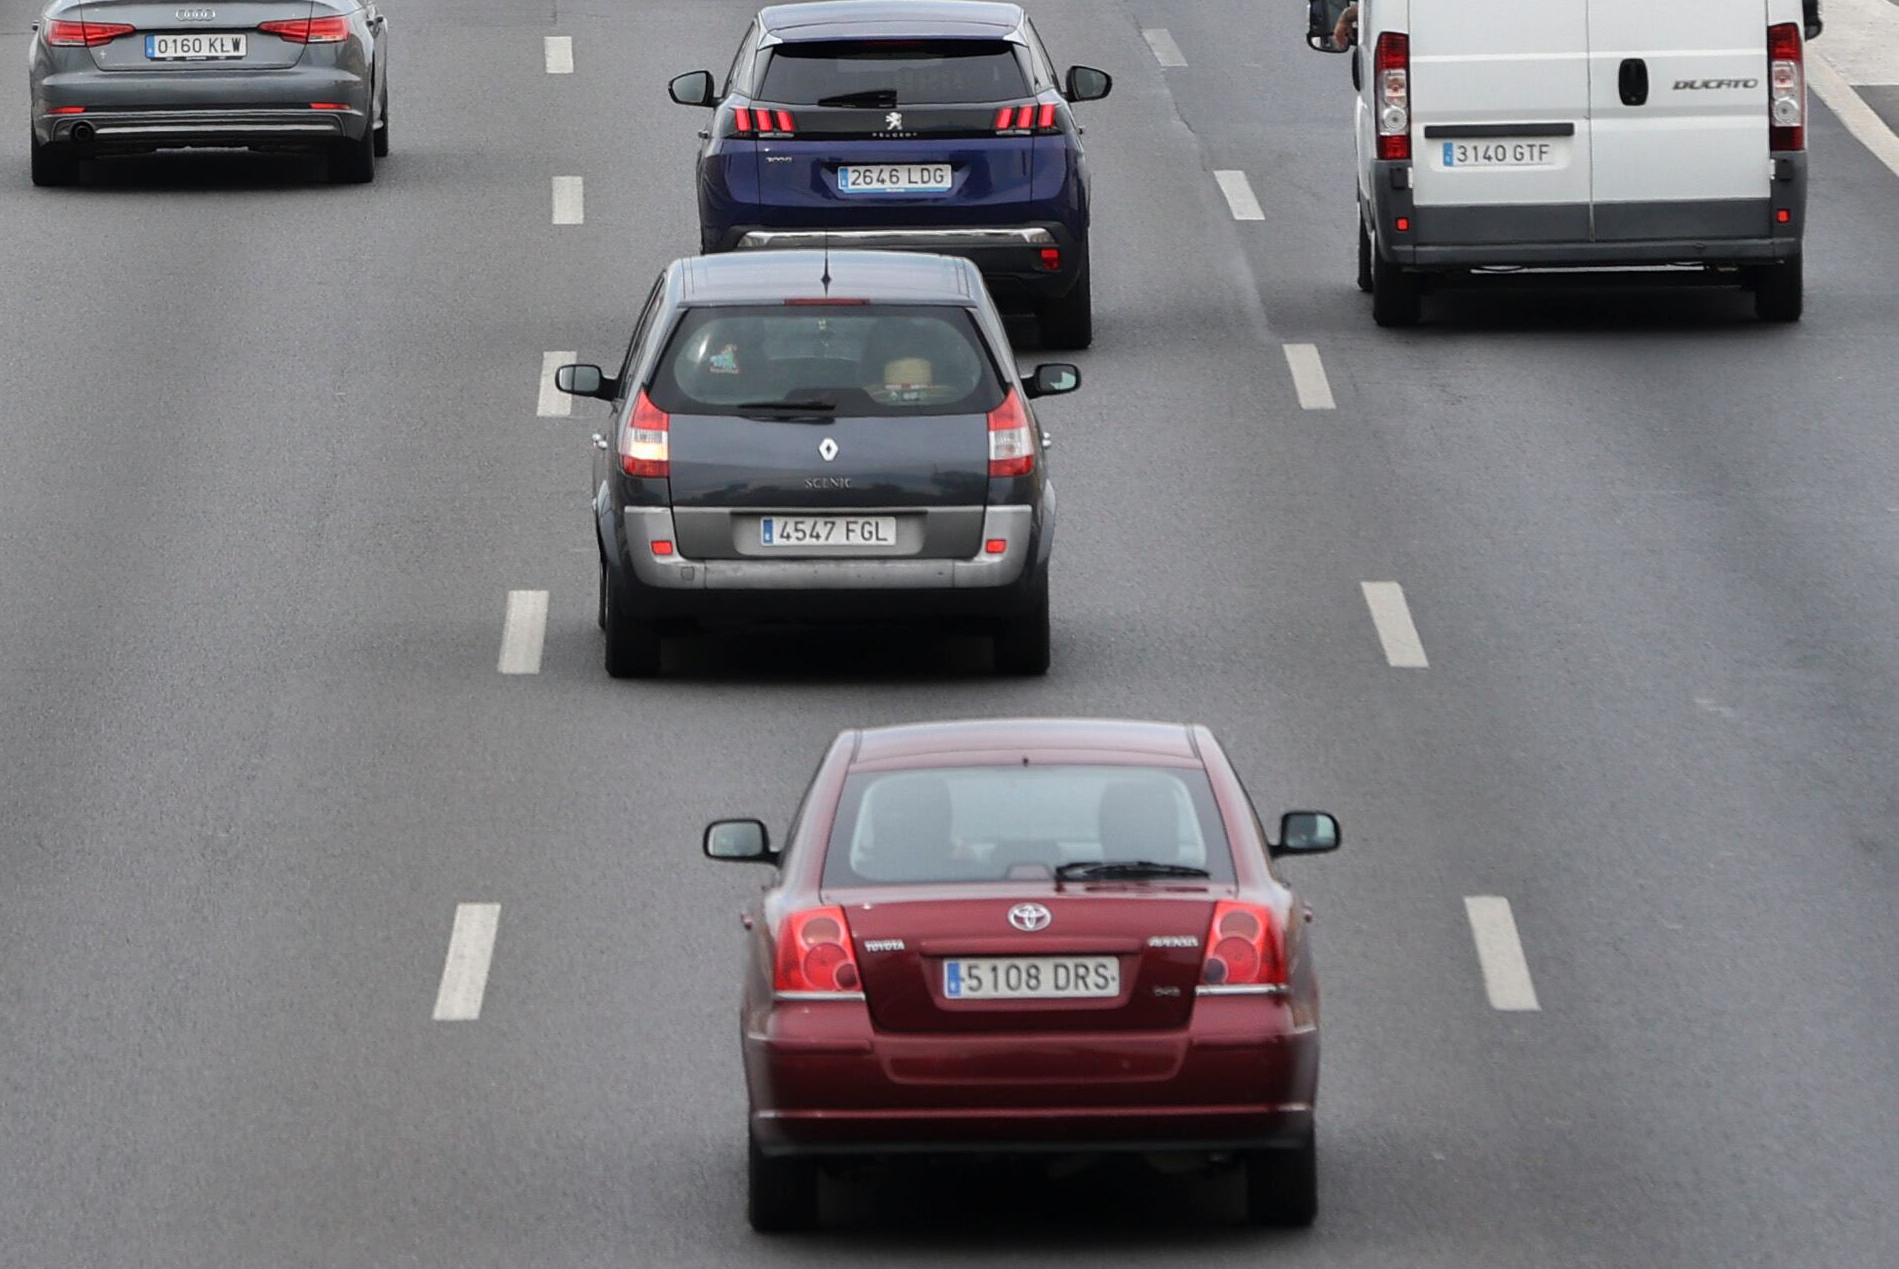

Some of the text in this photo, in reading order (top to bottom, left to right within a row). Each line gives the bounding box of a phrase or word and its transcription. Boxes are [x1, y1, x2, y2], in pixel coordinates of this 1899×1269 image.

[158, 37, 241, 53] 0160 KLW
[1672, 78, 1758, 91] DUCATO
[1457, 143, 1550, 162] 3140 GTF
[850, 167, 944, 185] 2646 LDG
[778, 520, 888, 542] 4547 FGL
[864, 939, 905, 951] TOYOTA
[967, 963, 1109, 992] 5108 DRS
